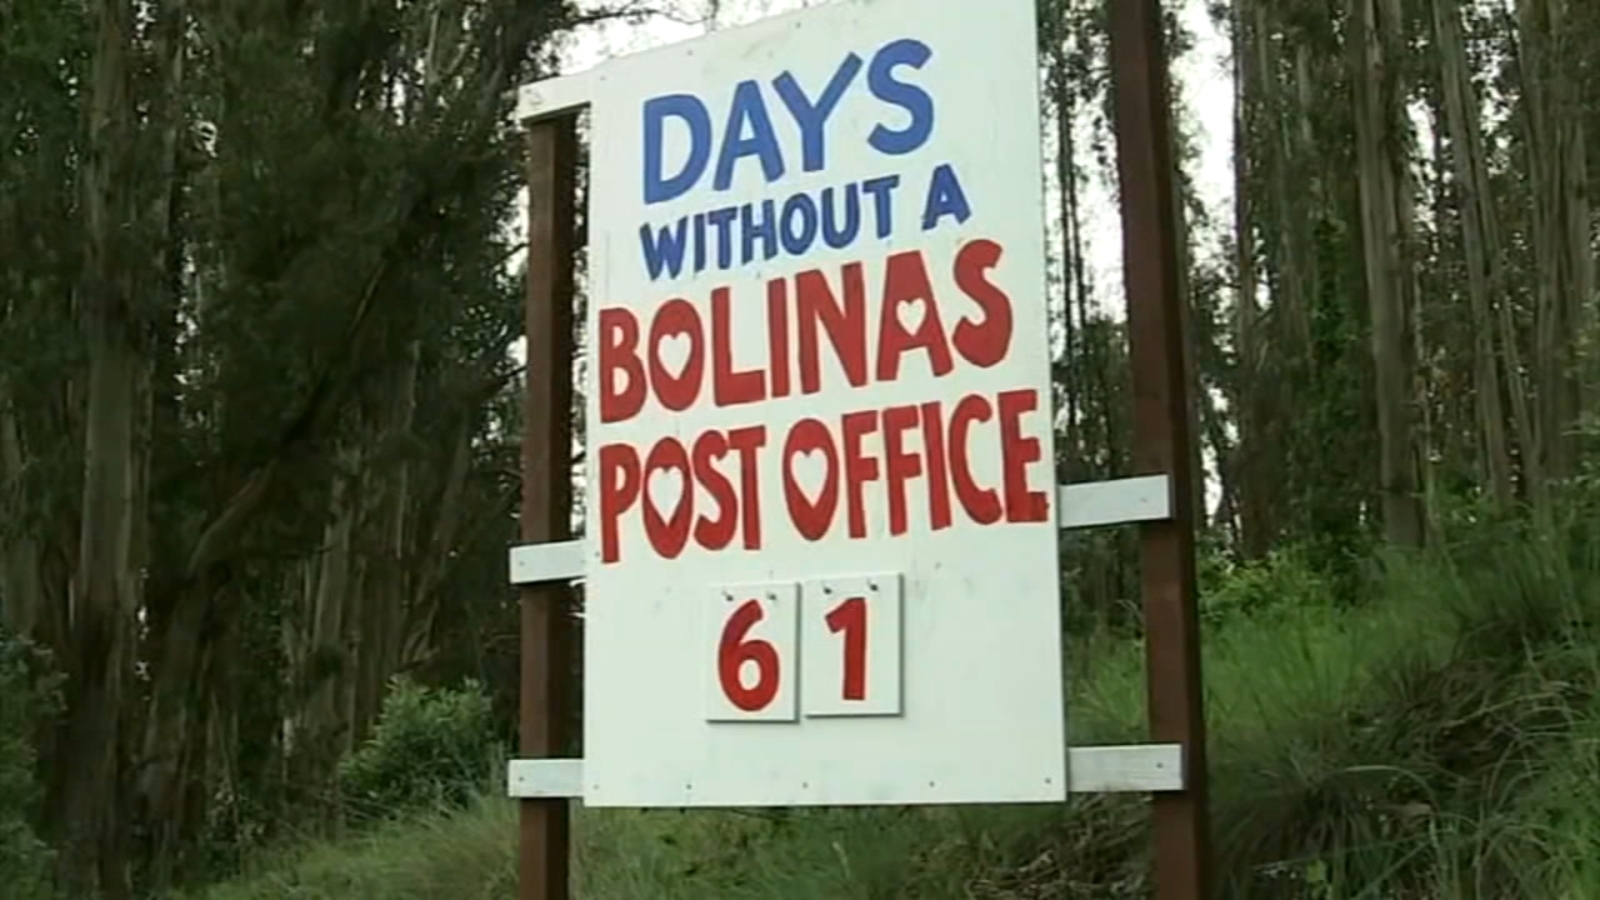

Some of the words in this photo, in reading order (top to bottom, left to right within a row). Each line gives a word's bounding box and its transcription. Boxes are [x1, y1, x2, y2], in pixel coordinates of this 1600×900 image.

[643, 39, 934, 204] DAYS
[640, 175, 899, 280] WITHOUT
[922, 164, 970, 230] A
[599, 239, 1013, 423] BOLINAS
[599, 426, 766, 563] POST
[783, 389, 1049, 541] OFFICE
[718, 597, 867, 712] 61
